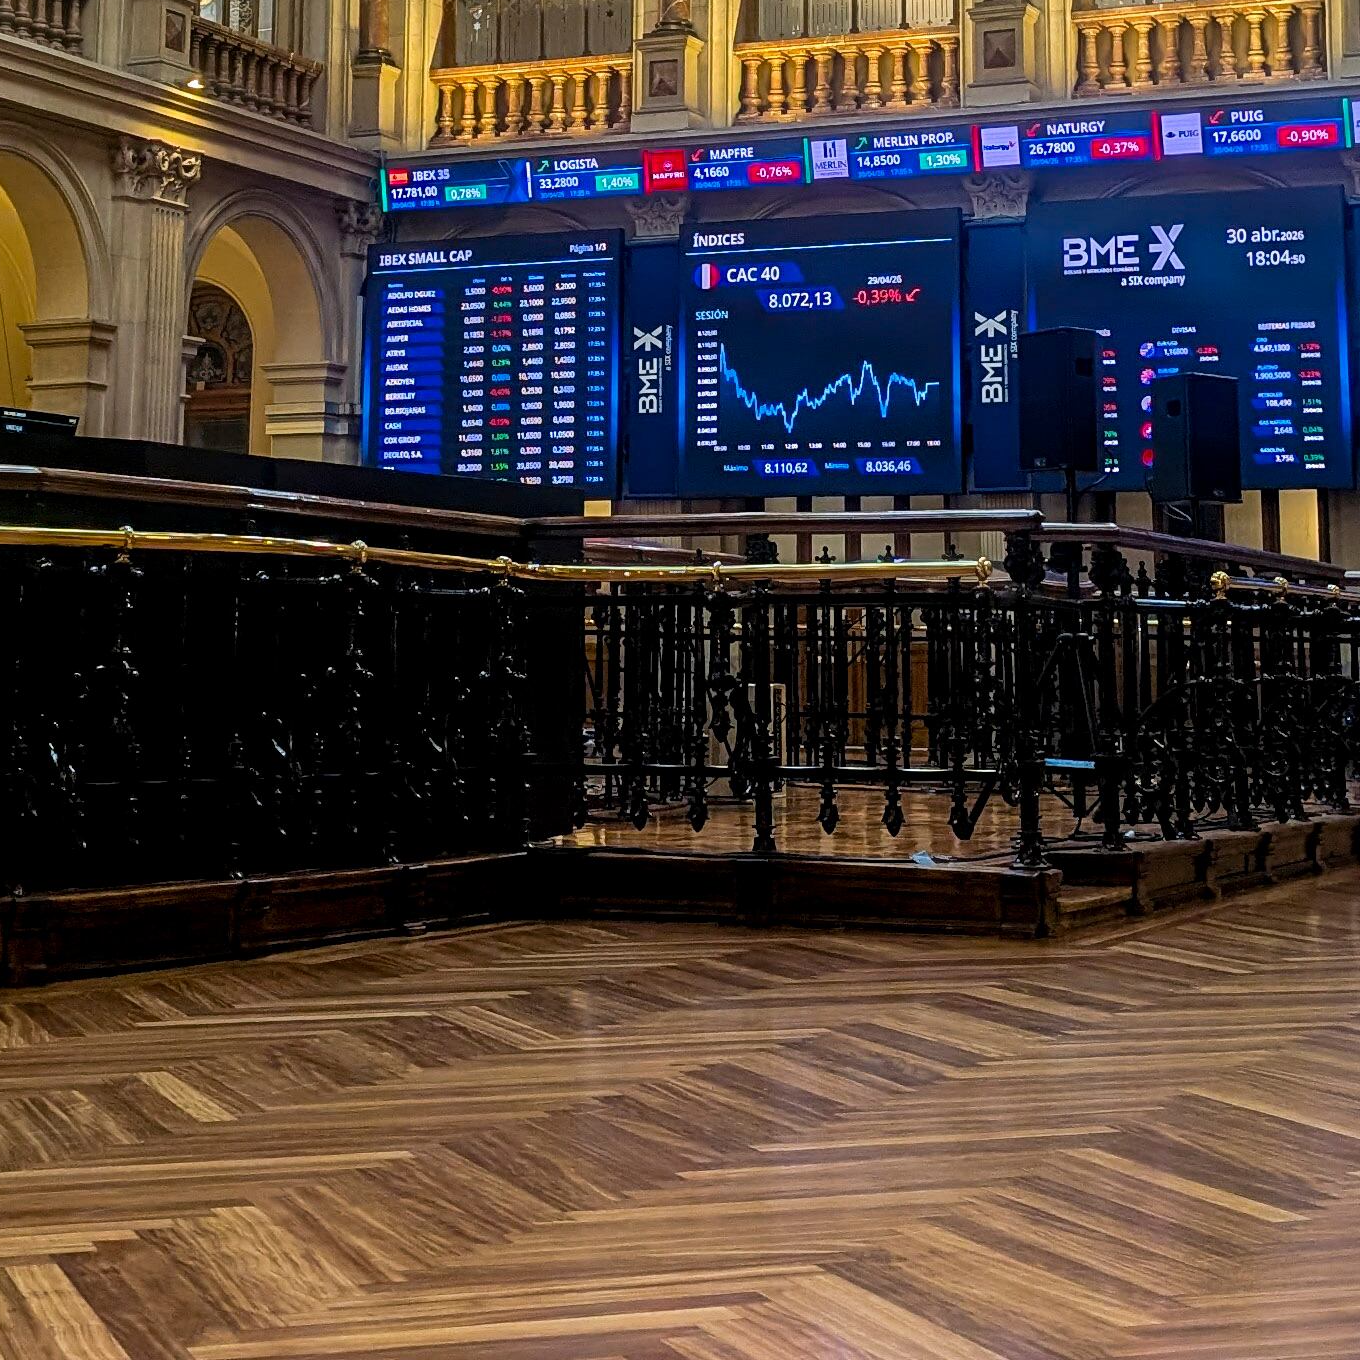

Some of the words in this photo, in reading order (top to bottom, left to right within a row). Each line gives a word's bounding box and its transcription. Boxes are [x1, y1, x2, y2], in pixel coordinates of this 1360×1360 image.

[1230, 109, 1264, 124] PUIG
[1046, 120, 1106, 137] NATURGY
[1212, 128, 1262, 144] 17,6600
[1285, 128, 1329, 143] -0,90%
[872, 134, 919, 150] MERLIN
[921, 132, 956, 146] PROP.
[1028, 141, 1076, 156] 26,7800
[1098, 140, 1140, 155] -0,37%
[709, 146, 755, 161] MAPFRE
[856, 153, 901, 169] 14,8500
[926, 152, 961, 166] 1,30%
[554, 157, 599, 171] LOGISTA
[814, 158, 849, 171] MERLIN
[412, 170, 437, 182] IBEX
[437, 168, 451, 181] 35
[693, 165, 730, 180] 4,1660
[756, 165, 793, 178] -0,76%
[539, 177, 579, 190] 33,2800
[601, 176, 633, 189] 1,40%
[391, 186, 438, 200] 17.781,00
[450, 187, 481, 201] 0,78%
[693, 231, 745, 248] ÍNDICES
[1226, 228, 1247, 244] 30
[595, 242, 607, 252] 1/3
[1063, 234, 1140, 269] BME
[379, 252, 407, 267] IBEX
[409, 250, 447, 265] SMALL
[449, 249, 473, 262] CAP
[726, 267, 758, 283] CAC
[760, 265, 780, 282] 40
[1120, 278, 1127, 287] a
[1128, 275, 1143, 287] SIX
[1144, 274, 1186, 289] company
[768, 290, 833, 309] 8.072,13
[852, 288, 902, 306] -0,39%
[695, 309, 729, 321] SESIÓN
[980, 344, 1003, 403] BME
[638, 357, 658, 414] BME
[764, 461, 808, 475] 8.110,62
[865, 459, 912, 473] 8.036,46
